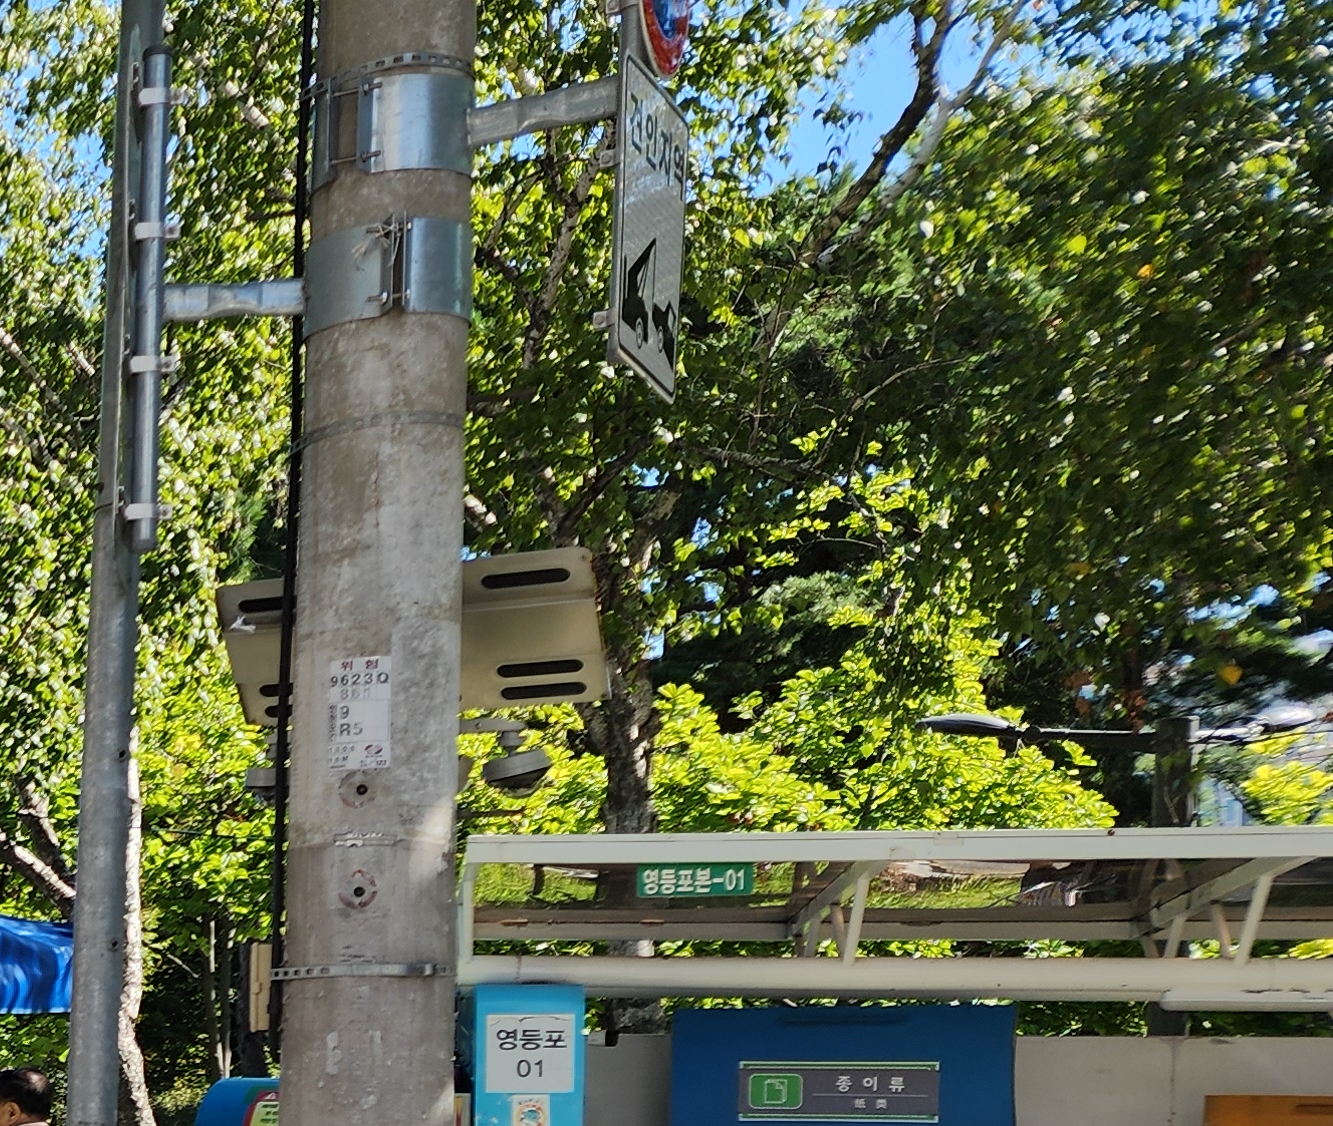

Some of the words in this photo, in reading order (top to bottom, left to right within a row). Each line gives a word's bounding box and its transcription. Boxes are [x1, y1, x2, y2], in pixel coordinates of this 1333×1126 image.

[630, 92, 686, 201] 견인지역
[643, 867, 745, 895] 영등포본-01
[496, 1028, 567, 1051] 영등포
[516, 1059, 544, 1078] 01
[835, 1075, 905, 1093] 종이류
